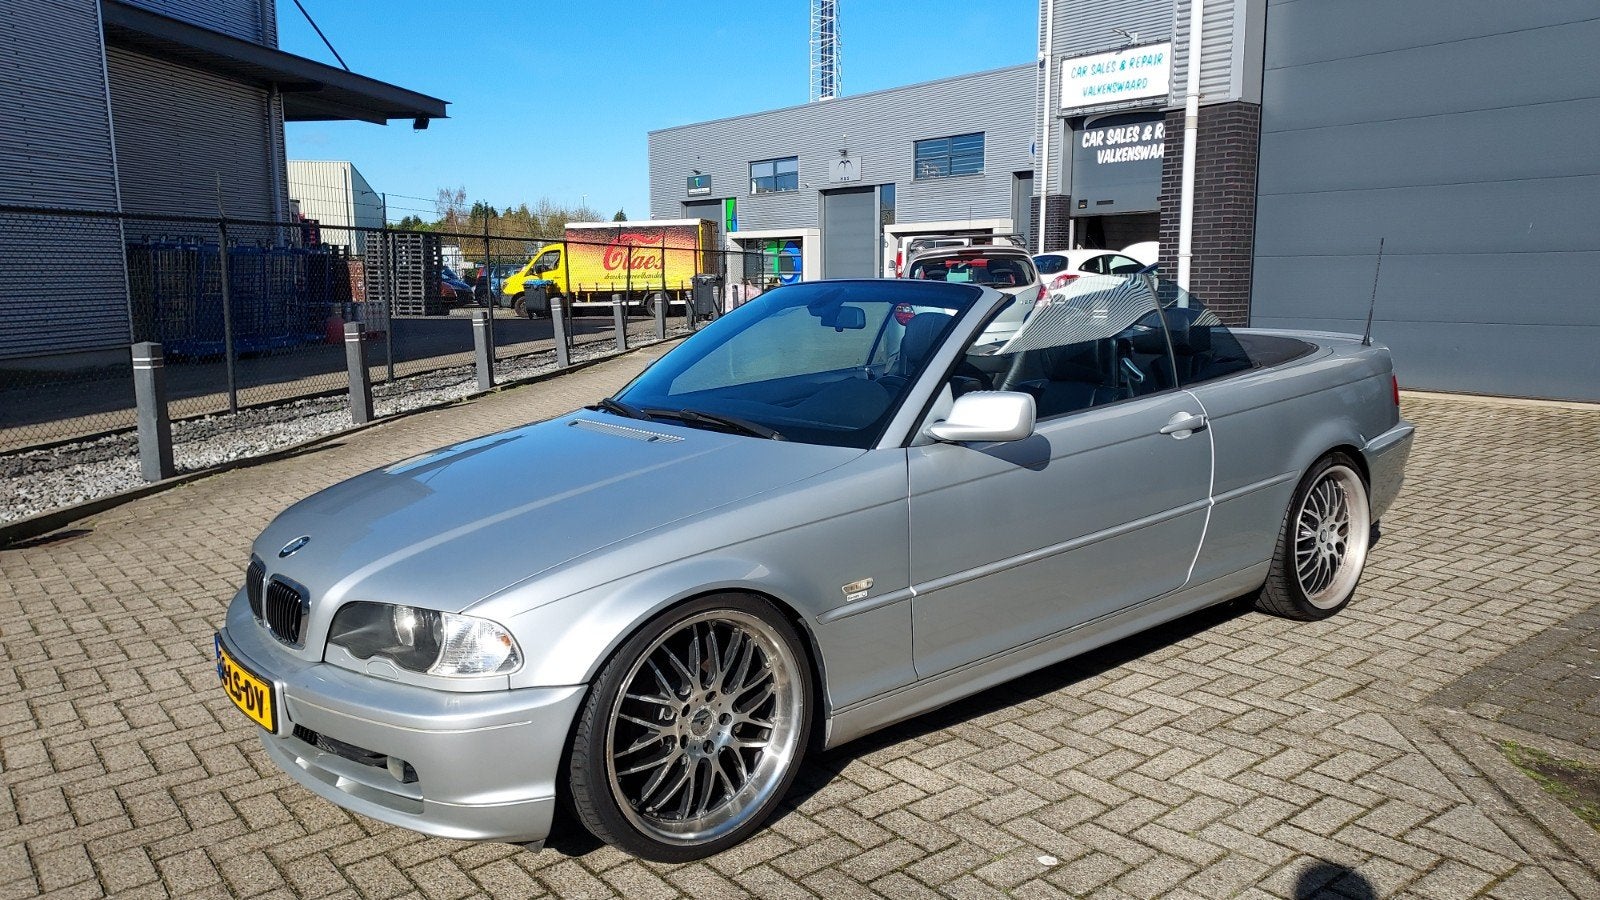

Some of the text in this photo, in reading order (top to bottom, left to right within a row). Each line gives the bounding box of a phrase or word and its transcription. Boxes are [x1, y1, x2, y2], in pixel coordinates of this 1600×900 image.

[1071, 53, 1164, 79] CAR SALES & REPAIR
[1082, 77, 1148, 97] VALKENSWAARD
[1082, 130, 1105, 148] CAR
[1106, 125, 1140, 146] SALES
[1142, 125, 1153, 141] &
[603, 233, 665, 270] Claes
